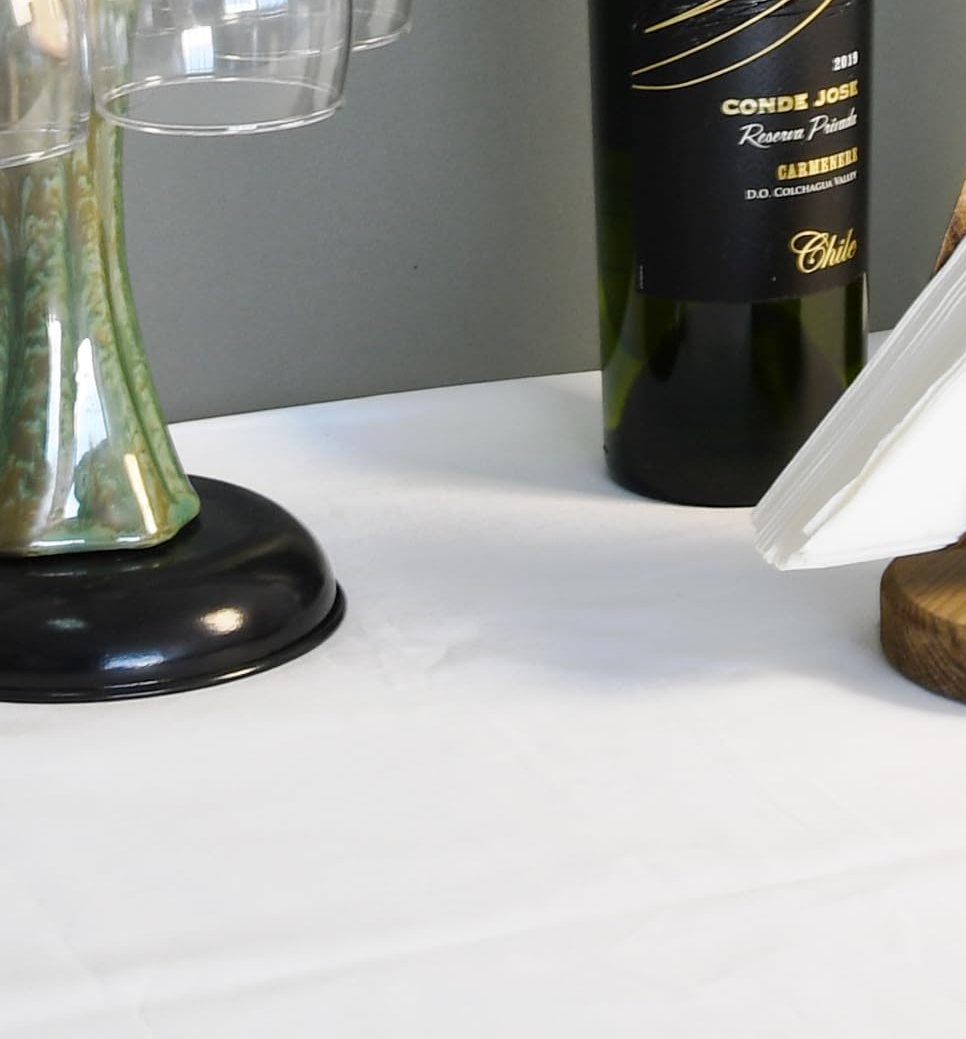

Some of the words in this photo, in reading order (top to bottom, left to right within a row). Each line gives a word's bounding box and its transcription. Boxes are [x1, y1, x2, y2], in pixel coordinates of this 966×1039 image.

[721, 92, 809, 115] CONDE
[813, 79, 858, 107] JOSE
[738, 123, 805, 149] Reserva
[777, 147, 858, 180] CARMENERE
[745, 188, 771, 200] D.O.
[790, 228, 857, 273] Chile
